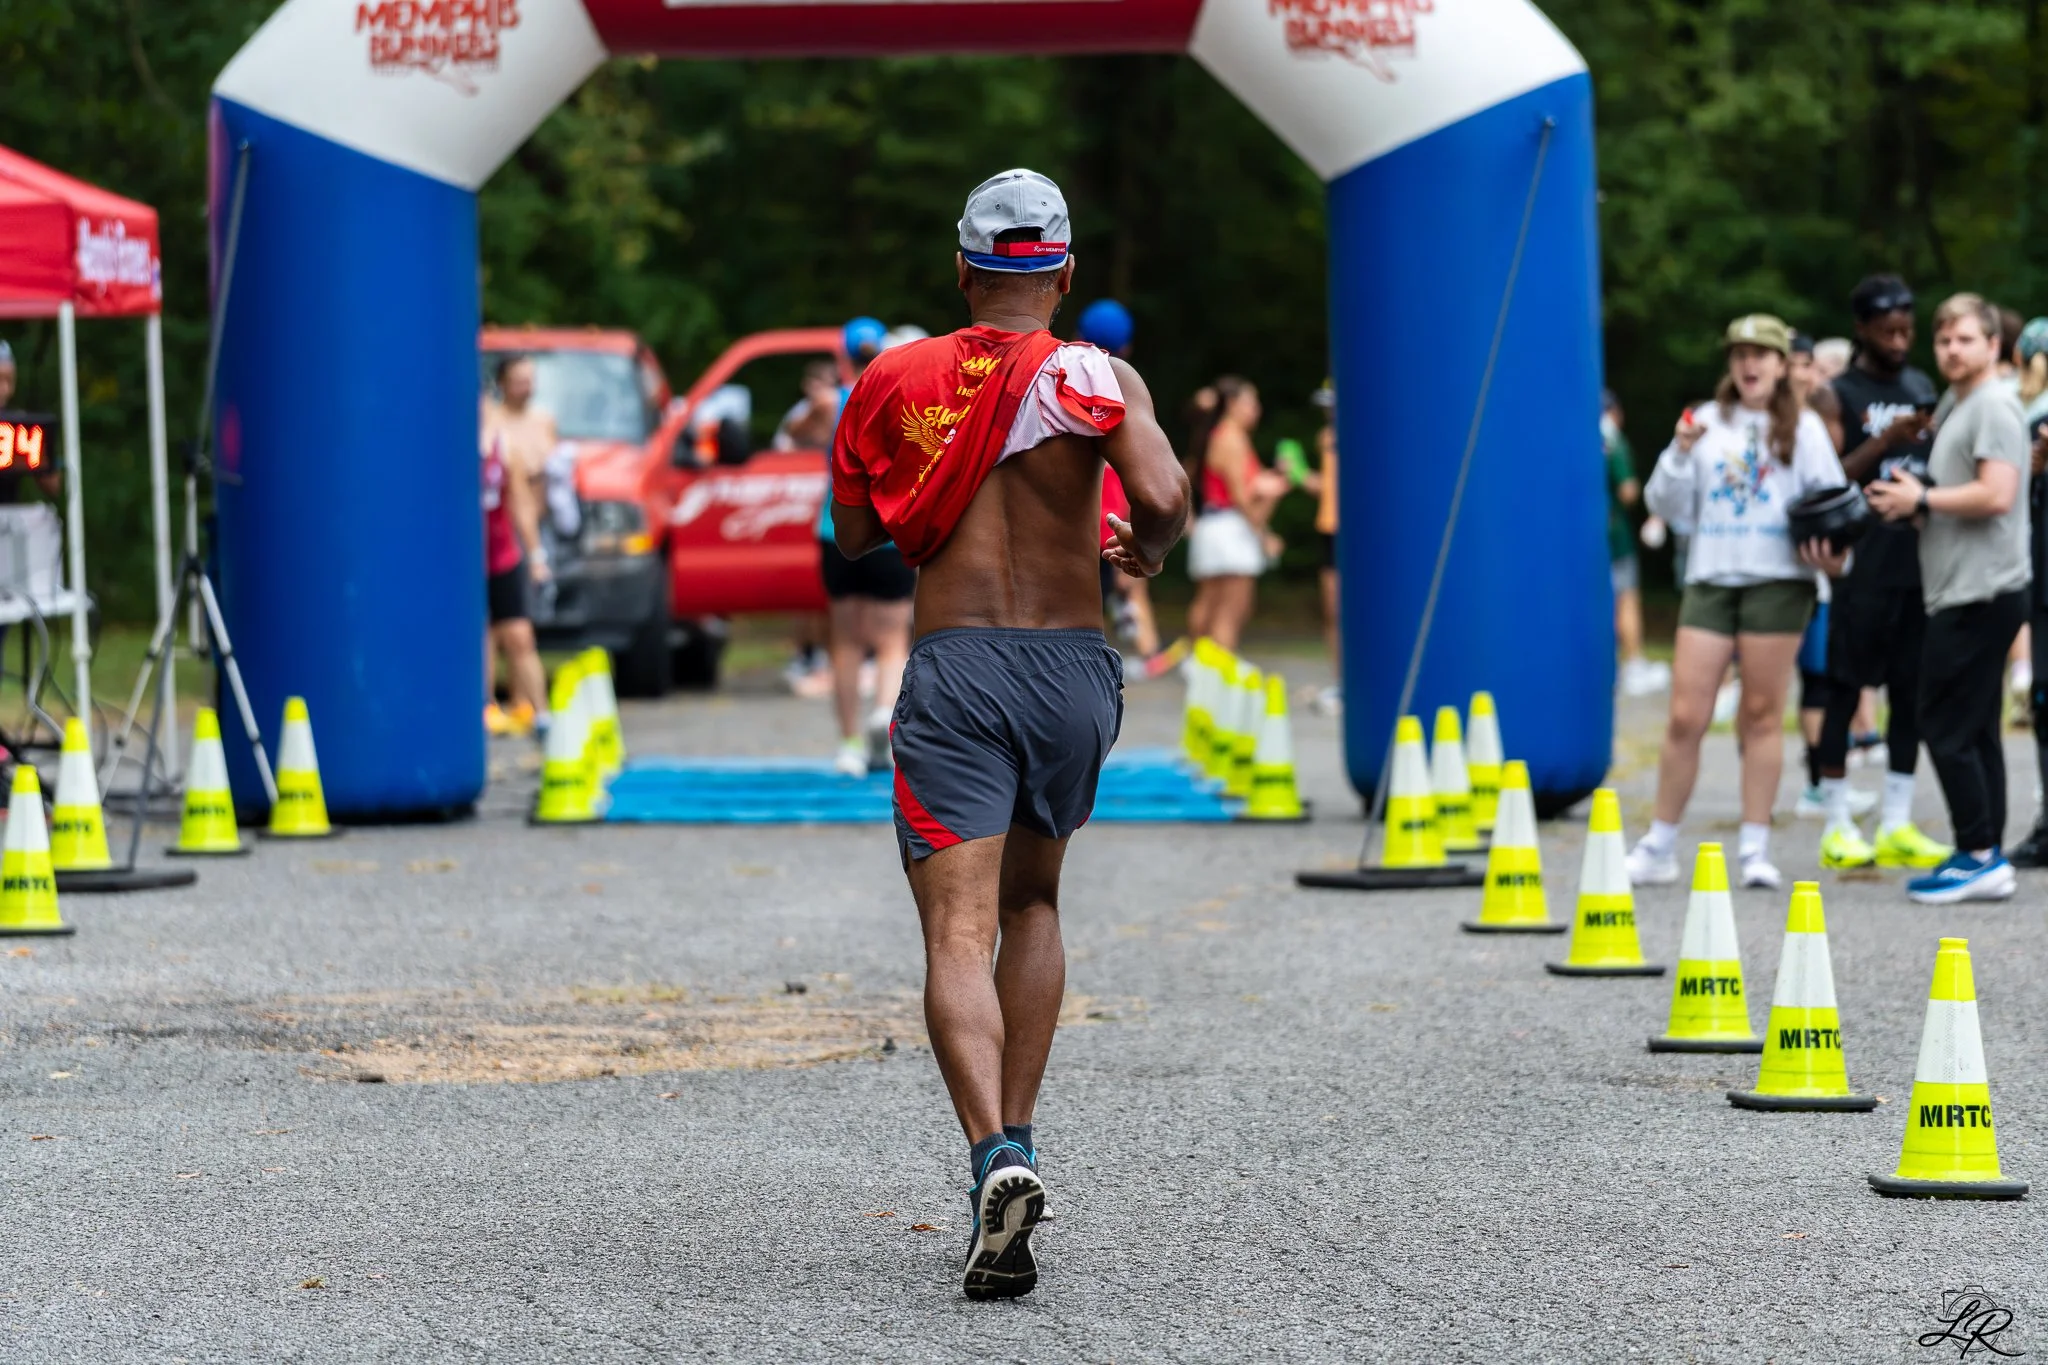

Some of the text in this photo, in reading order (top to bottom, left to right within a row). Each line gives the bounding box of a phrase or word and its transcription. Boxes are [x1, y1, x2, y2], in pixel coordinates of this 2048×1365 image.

[1680, 977, 1740, 997] MRTC
[1779, 1029, 1841, 1050] MRTC
[1919, 1104, 1991, 1128] MRTC
